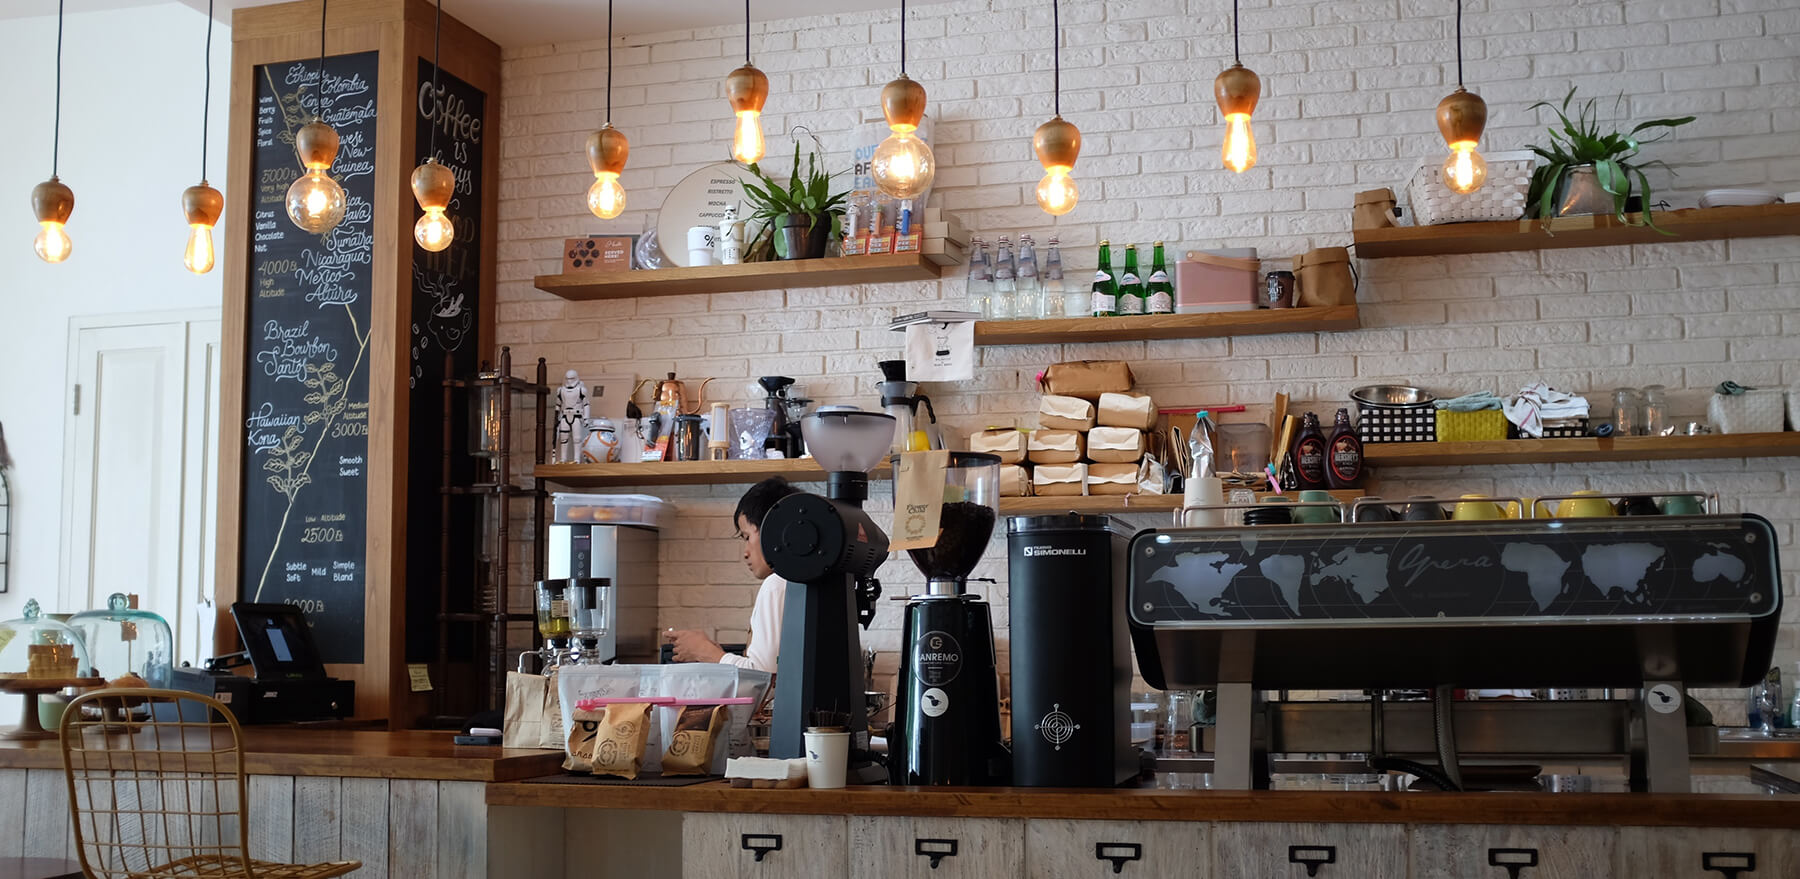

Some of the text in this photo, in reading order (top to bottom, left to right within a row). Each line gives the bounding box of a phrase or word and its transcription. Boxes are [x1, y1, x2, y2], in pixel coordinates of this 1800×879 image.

[320, 73, 369, 97] Colombia
[321, 100, 377, 126] Guatemala
[419, 81, 481, 144] Coffee
[341, 145, 373, 159] New
[454, 140, 468, 164] is
[262, 168, 290, 183] 5000
[331, 158, 374, 178] Guinea
[255, 221, 276, 231] Vanilla
[255, 231, 284, 241] Chocolate
[327, 226, 374, 252] Sumatra
[301, 248, 371, 269] Nicaragua
[258, 260, 289, 276] 4000
[295, 268, 355, 286] Mexico
[305, 283, 357, 305] Altura
[264, 320, 310, 340] Brazil
[281, 336, 337, 361] Bourbon
[257, 346, 307, 381] Santos
[246, 402, 306, 433] Hawaiian
[332, 423, 361, 438] 3000
[248, 429, 280, 450] Kona
[339, 456, 363, 465] Smooth
[339, 467, 359, 477] Sweet
[320, 513, 346, 522] Altitude
[301, 528, 335, 543] 2500
[285, 562, 307, 572] Subtle
[311, 567, 327, 576] Mild
[332, 561, 355, 572] Simple
[286, 573, 301, 582] Soft
[333, 572, 353, 581] Bland
[918, 653, 959, 662] ANREMO
